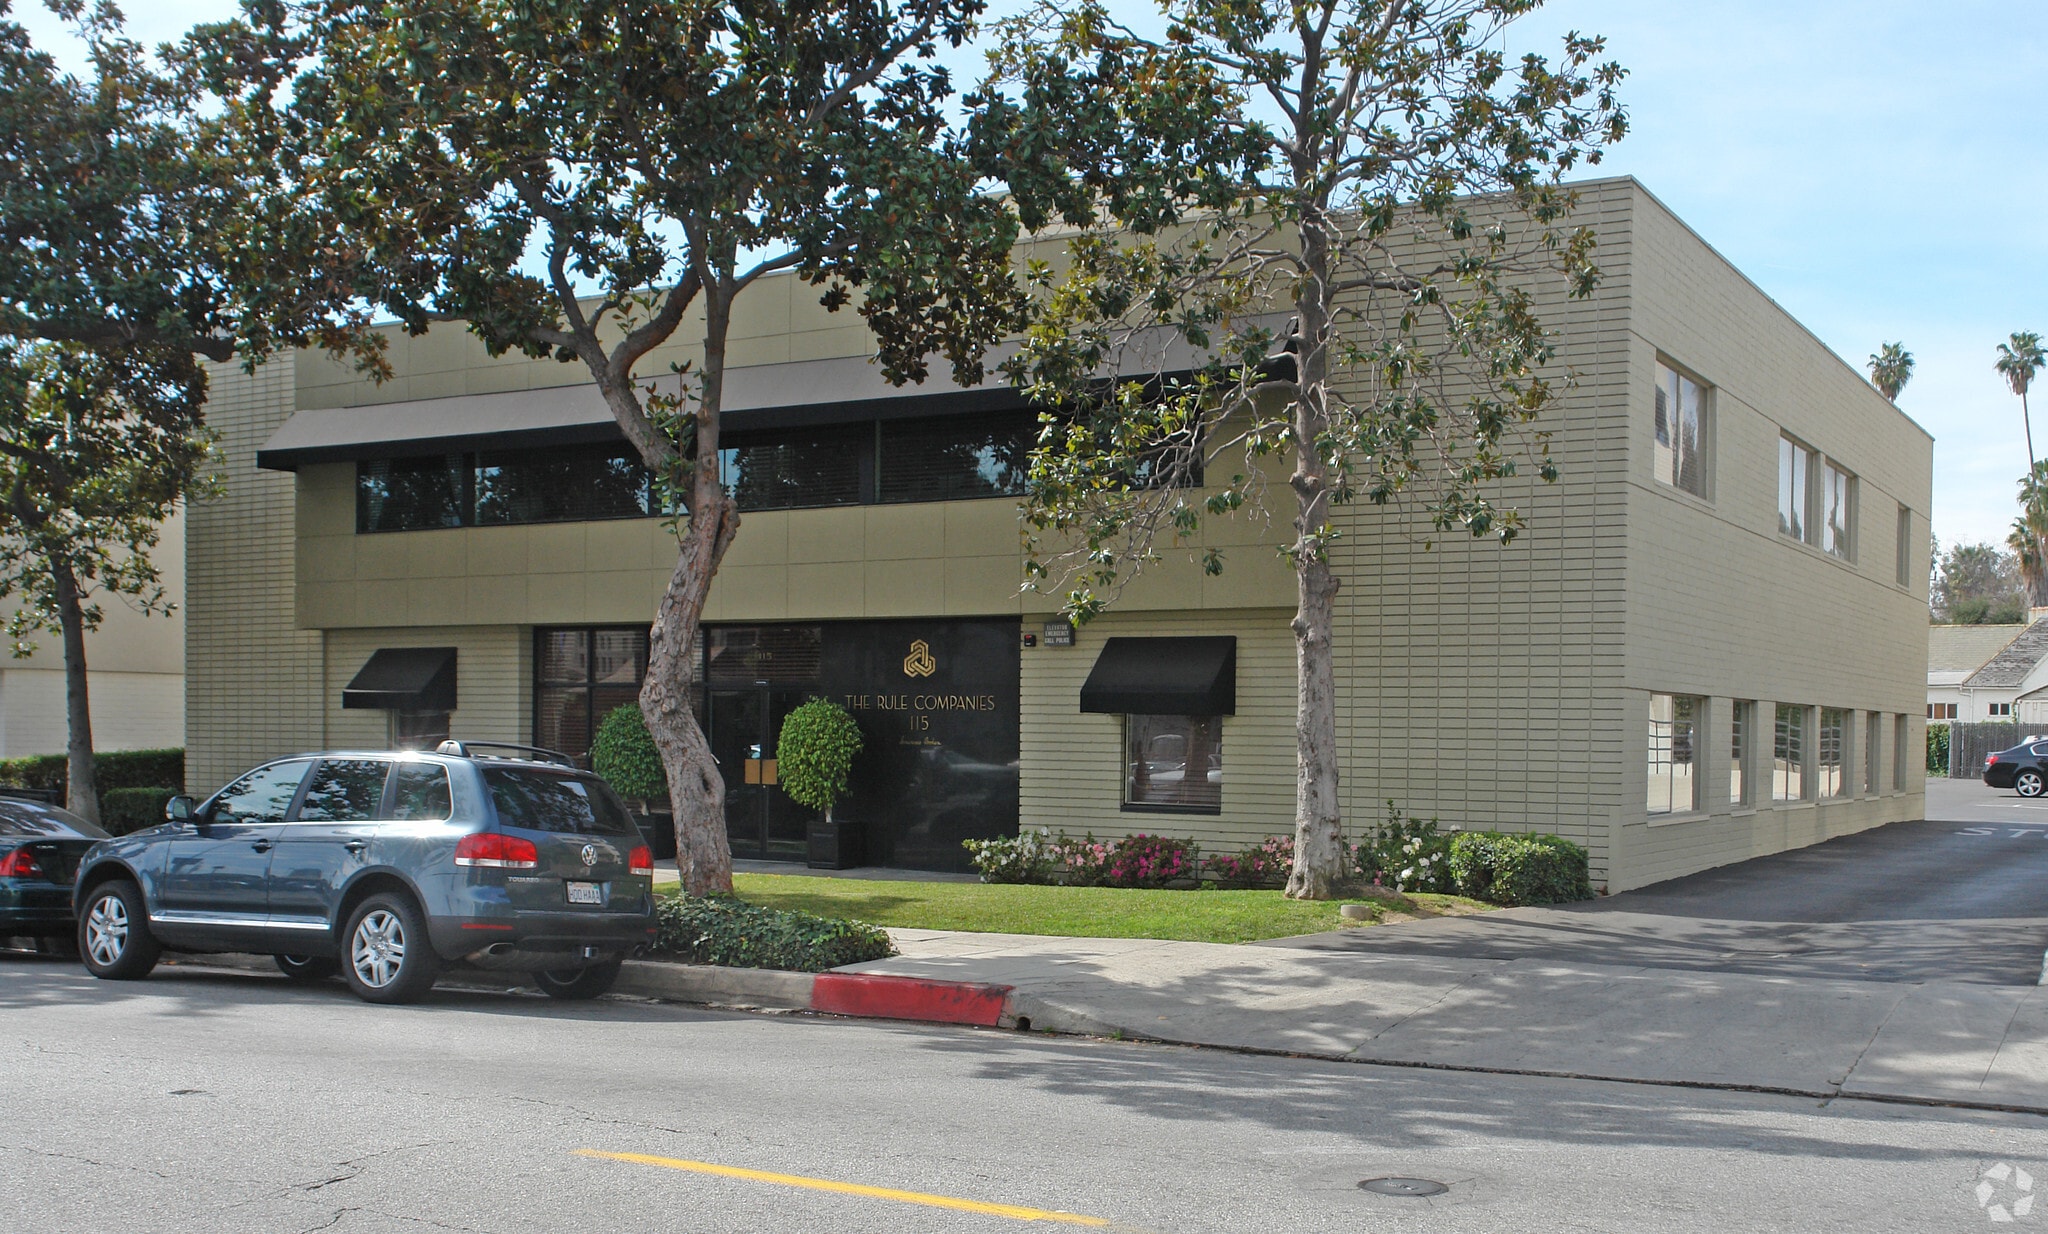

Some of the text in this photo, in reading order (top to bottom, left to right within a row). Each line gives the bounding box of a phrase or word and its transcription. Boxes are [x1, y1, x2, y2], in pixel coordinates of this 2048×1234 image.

[845, 694, 995, 710] THE RULE COMPANIES
[910, 715, 929, 731] 115
[1953, 827, 2048, 840] ST
